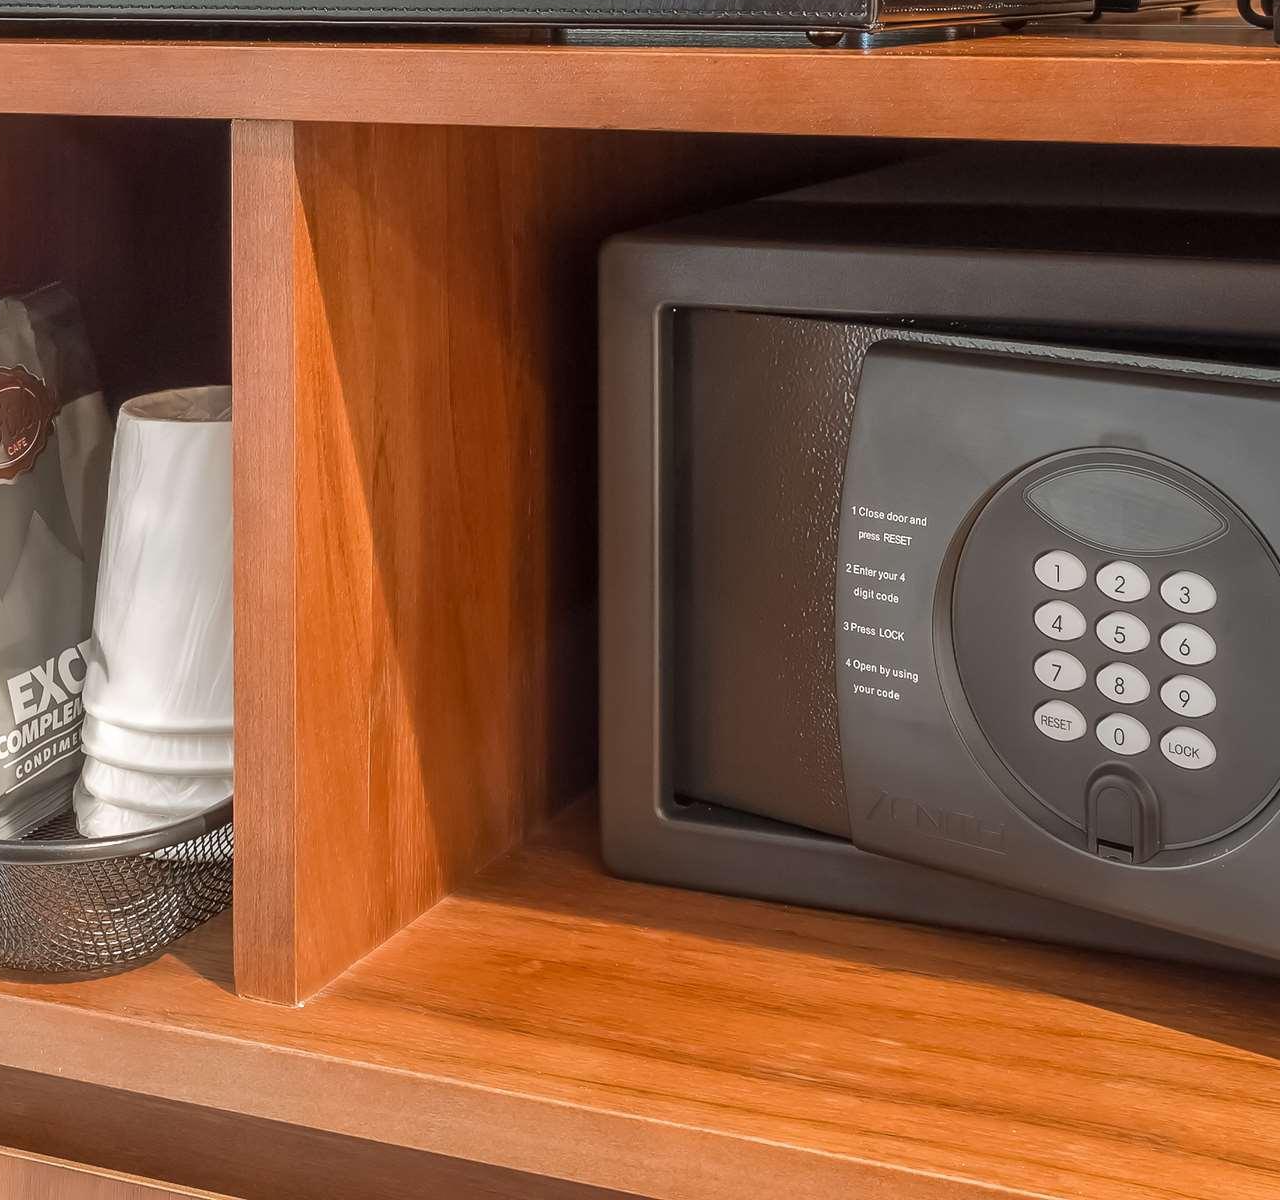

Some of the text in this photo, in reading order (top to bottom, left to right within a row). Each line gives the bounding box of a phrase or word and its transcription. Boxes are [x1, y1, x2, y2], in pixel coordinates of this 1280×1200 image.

[852, 506, 927, 526] 1 Close door and
[858, 531, 912, 546] press RESET
[846, 563, 906, 582] 2 Enter your 4
[1054, 564, 1060, 583] 1
[1114, 575, 1126, 594] 2
[853, 587, 899, 603] digit code
[1179, 586, 1191, 605] 3
[843, 621, 905, 641] 3 Press LOCK
[1051, 614, 1063, 633] 4
[1113, 625, 1126, 644] 5
[1179, 638, 1191, 656] 6
[845, 658, 919, 683] 4 Open by using
[1051, 663, 1062, 682] 7
[7, 638, 91, 725] EXC
[1114, 676, 1125, 695] 8
[853, 683, 900, 700] your code
[1179, 689, 1190, 708] 9
[1040, 714, 1073, 731] RESET
[1113, 727, 1125, 746] 0
[16, 728, 82, 779] CONDIME
[1168, 742, 1200, 760] LOCK
